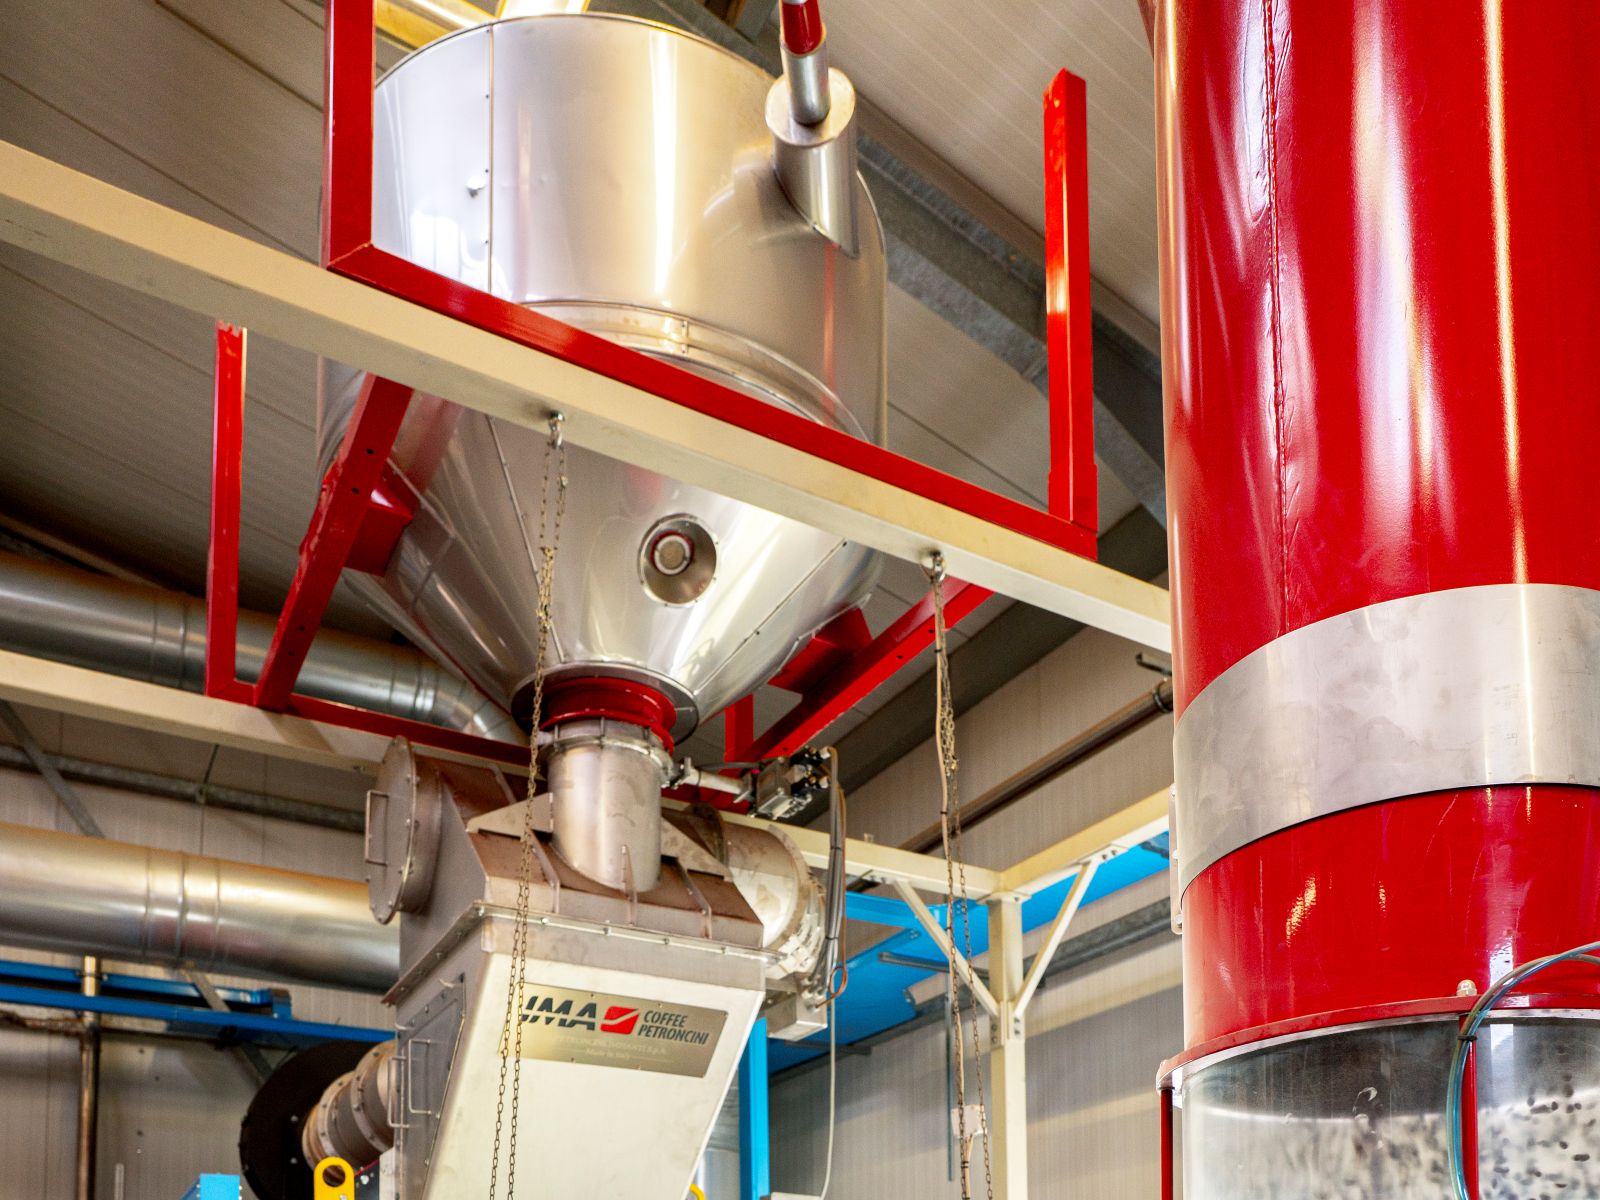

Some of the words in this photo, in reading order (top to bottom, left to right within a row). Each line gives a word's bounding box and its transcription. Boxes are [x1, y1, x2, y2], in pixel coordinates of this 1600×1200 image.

[521, 996, 597, 1031] IMA
[643, 1010, 688, 1028] COFFEE
[637, 1025, 710, 1045] PETRONCINI
